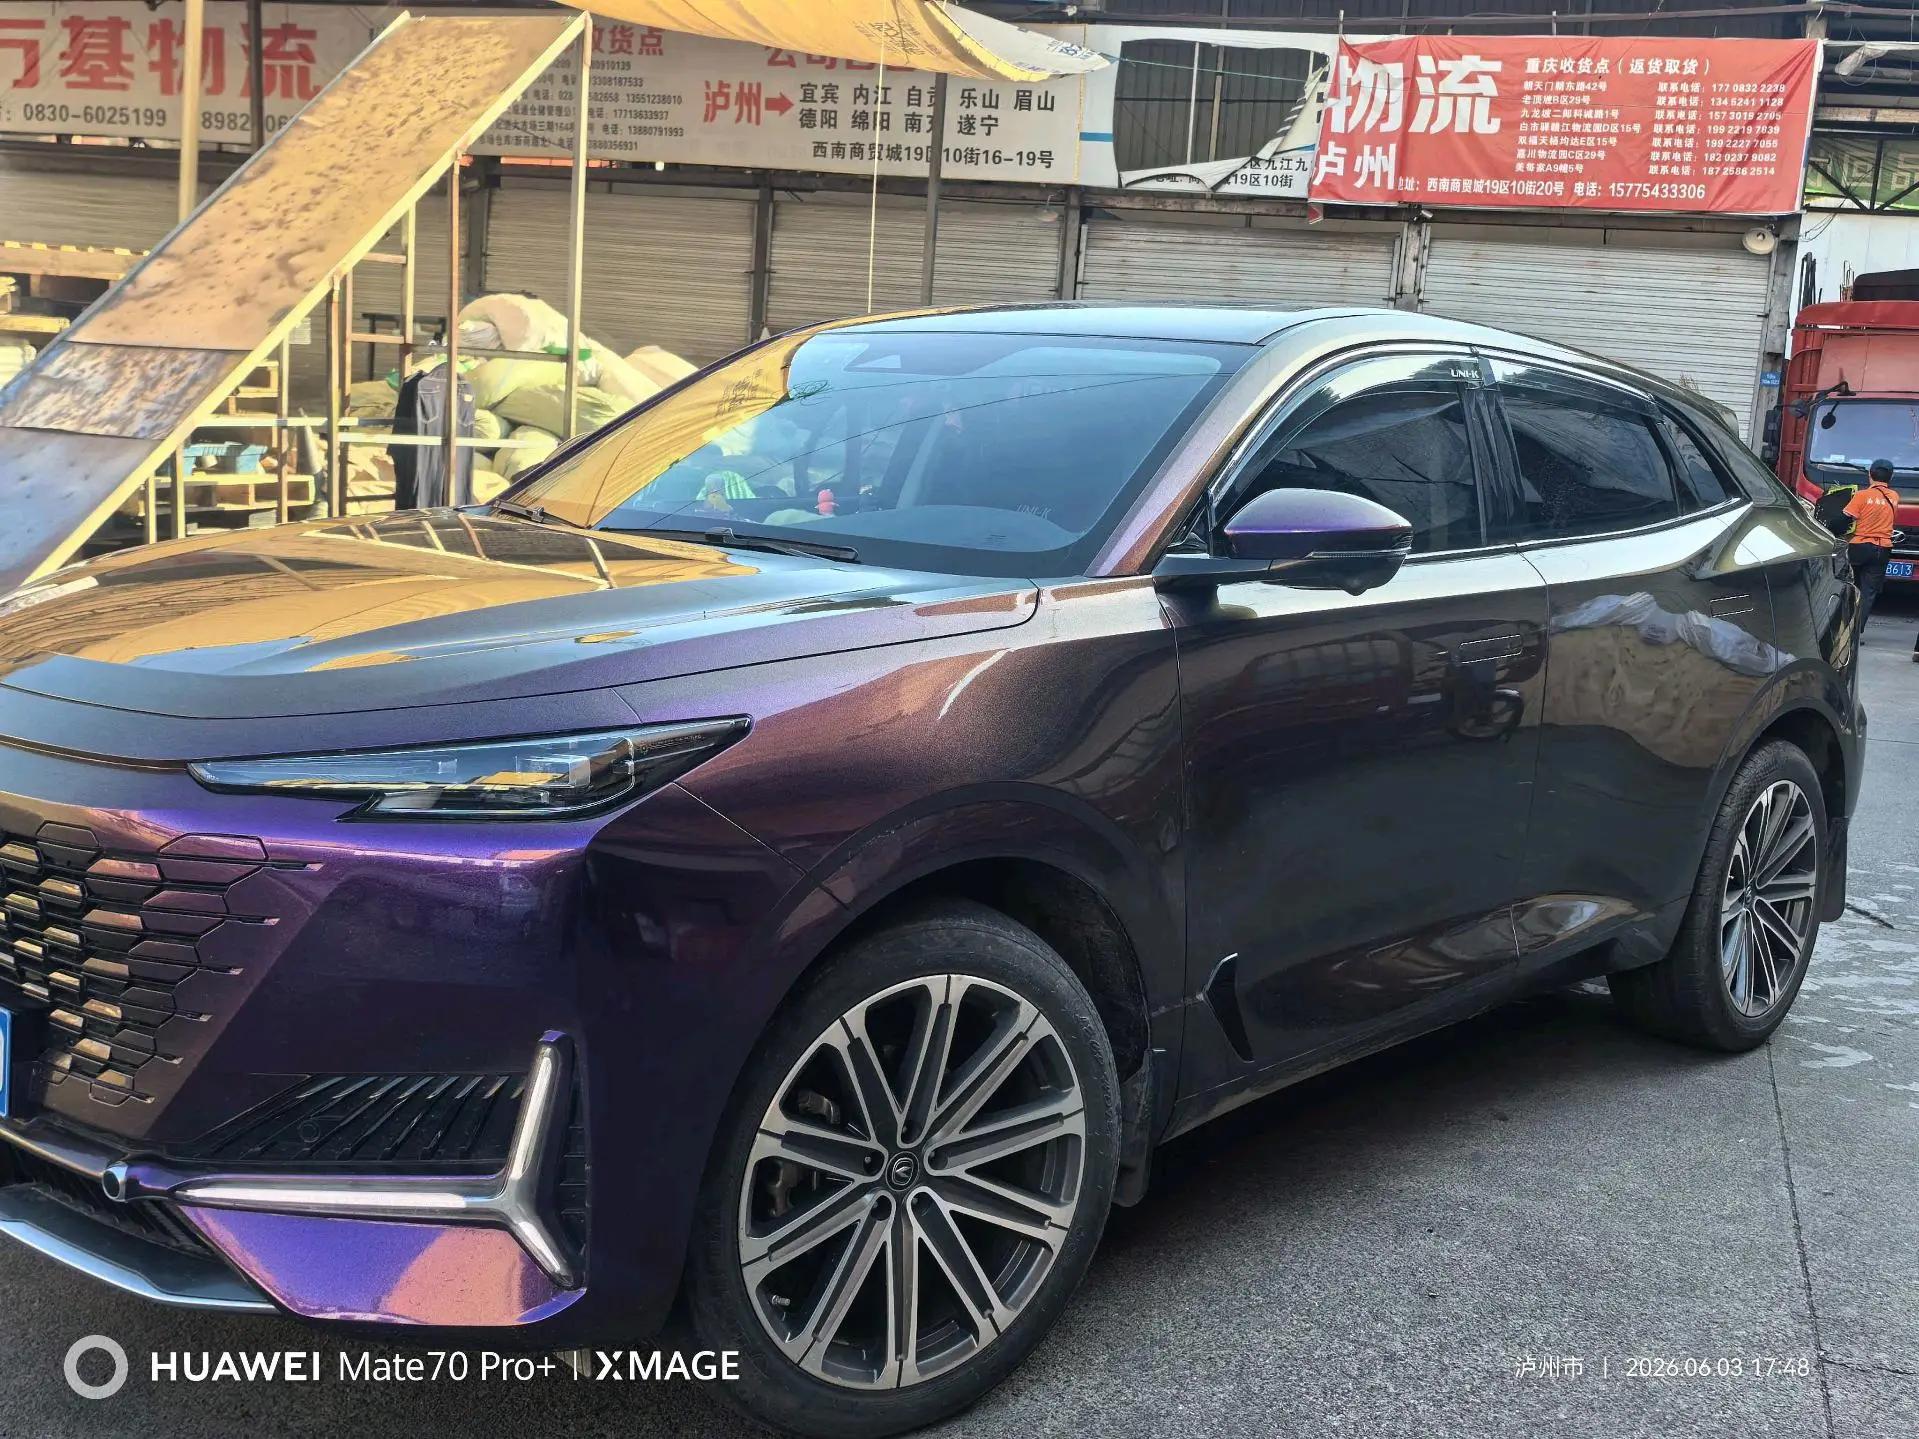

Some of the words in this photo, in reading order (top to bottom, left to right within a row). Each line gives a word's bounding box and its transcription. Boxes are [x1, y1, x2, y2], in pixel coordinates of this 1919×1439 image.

[799, 82, 841, 105] 宜宾
[852, 83, 893, 107] 内江
[959, 87, 1000, 110] 乐山
[1013, 88, 1056, 113] 眉山
[1324, 53, 1503, 135] 物流
[1712, 83, 1730, 93] 177
[23, 103, 167, 127] 0830-6025199
[704, 79, 762, 127] 泸州
[798, 108, 839, 131] 德阳
[851, 109, 891, 132] 绵阳
[957, 114, 1000, 137] 遂宁
[1426, 177, 1565, 197] 西南商贸城19区10街20号
[1573, 180, 1602, 198] 电话：
[1609, 182, 1706, 201] 15775433306
